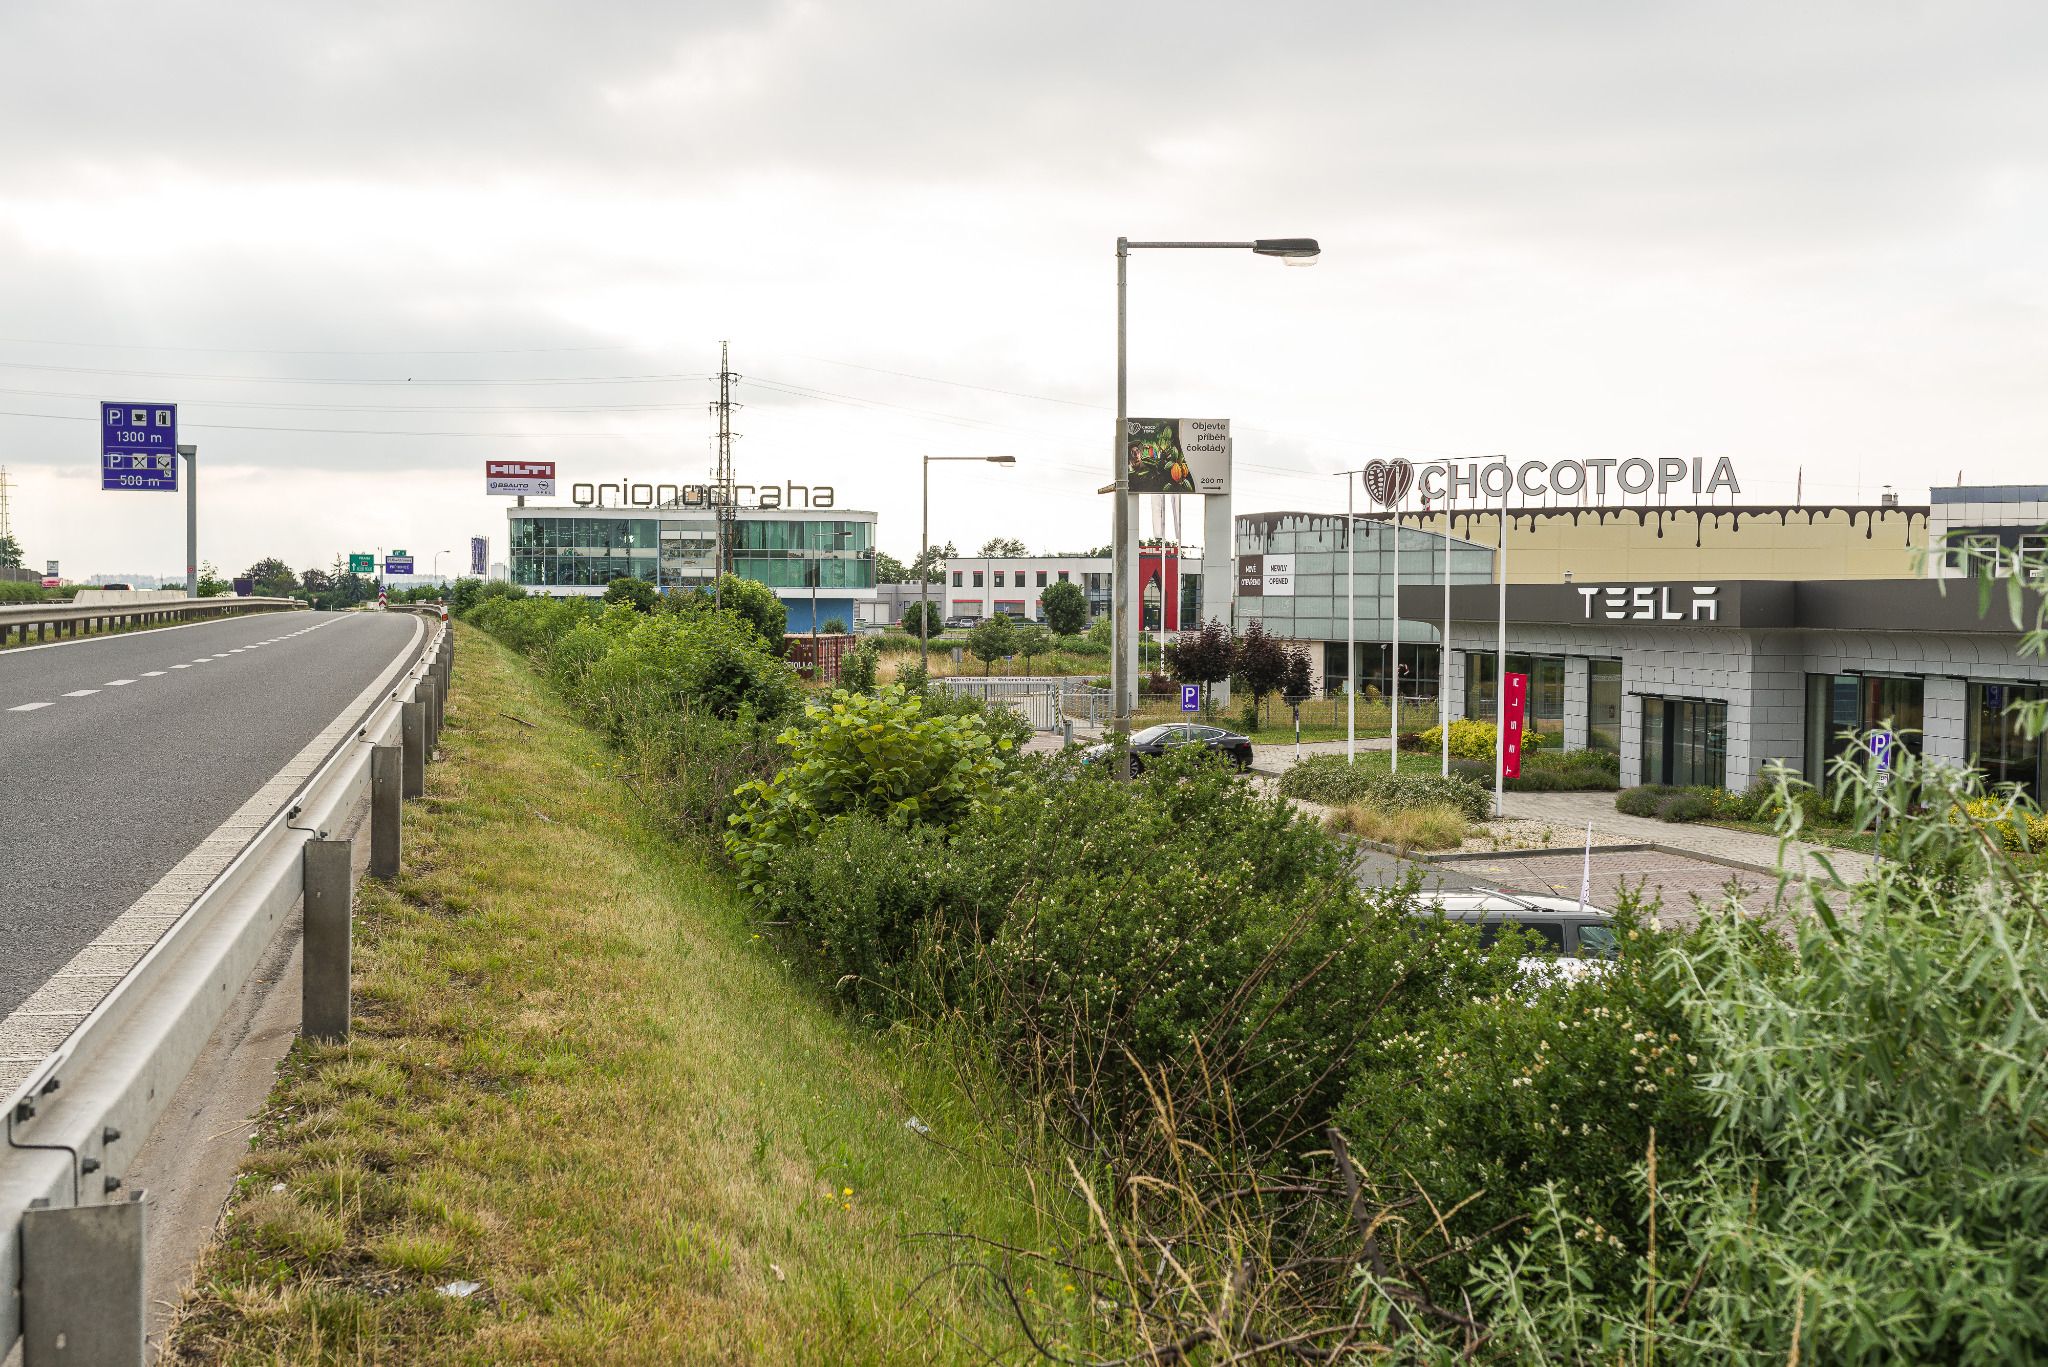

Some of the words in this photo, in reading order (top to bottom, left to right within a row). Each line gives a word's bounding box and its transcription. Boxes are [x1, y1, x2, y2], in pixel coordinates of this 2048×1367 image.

[109, 410, 121, 424] P
[1192, 422, 1226, 431] Objevte
[116, 431, 145, 442] 1300
[150, 434, 162, 443] m
[1197, 433, 1226, 442] příběh
[1186, 443, 1226, 454] čokolády
[110, 453, 121, 468] P
[490, 464, 551, 475] HILTI
[120, 474, 143, 486] 500
[148, 478, 160, 487] m
[1418, 456, 1741, 500] CHOCOTOPIA
[1270, 564, 1288, 572] NEWLY
[1268, 577, 1289, 585] OPENED
[1577, 586, 1719, 621] TESLA
[1185, 687, 1195, 703] P
[1874, 734, 1886, 756] P
